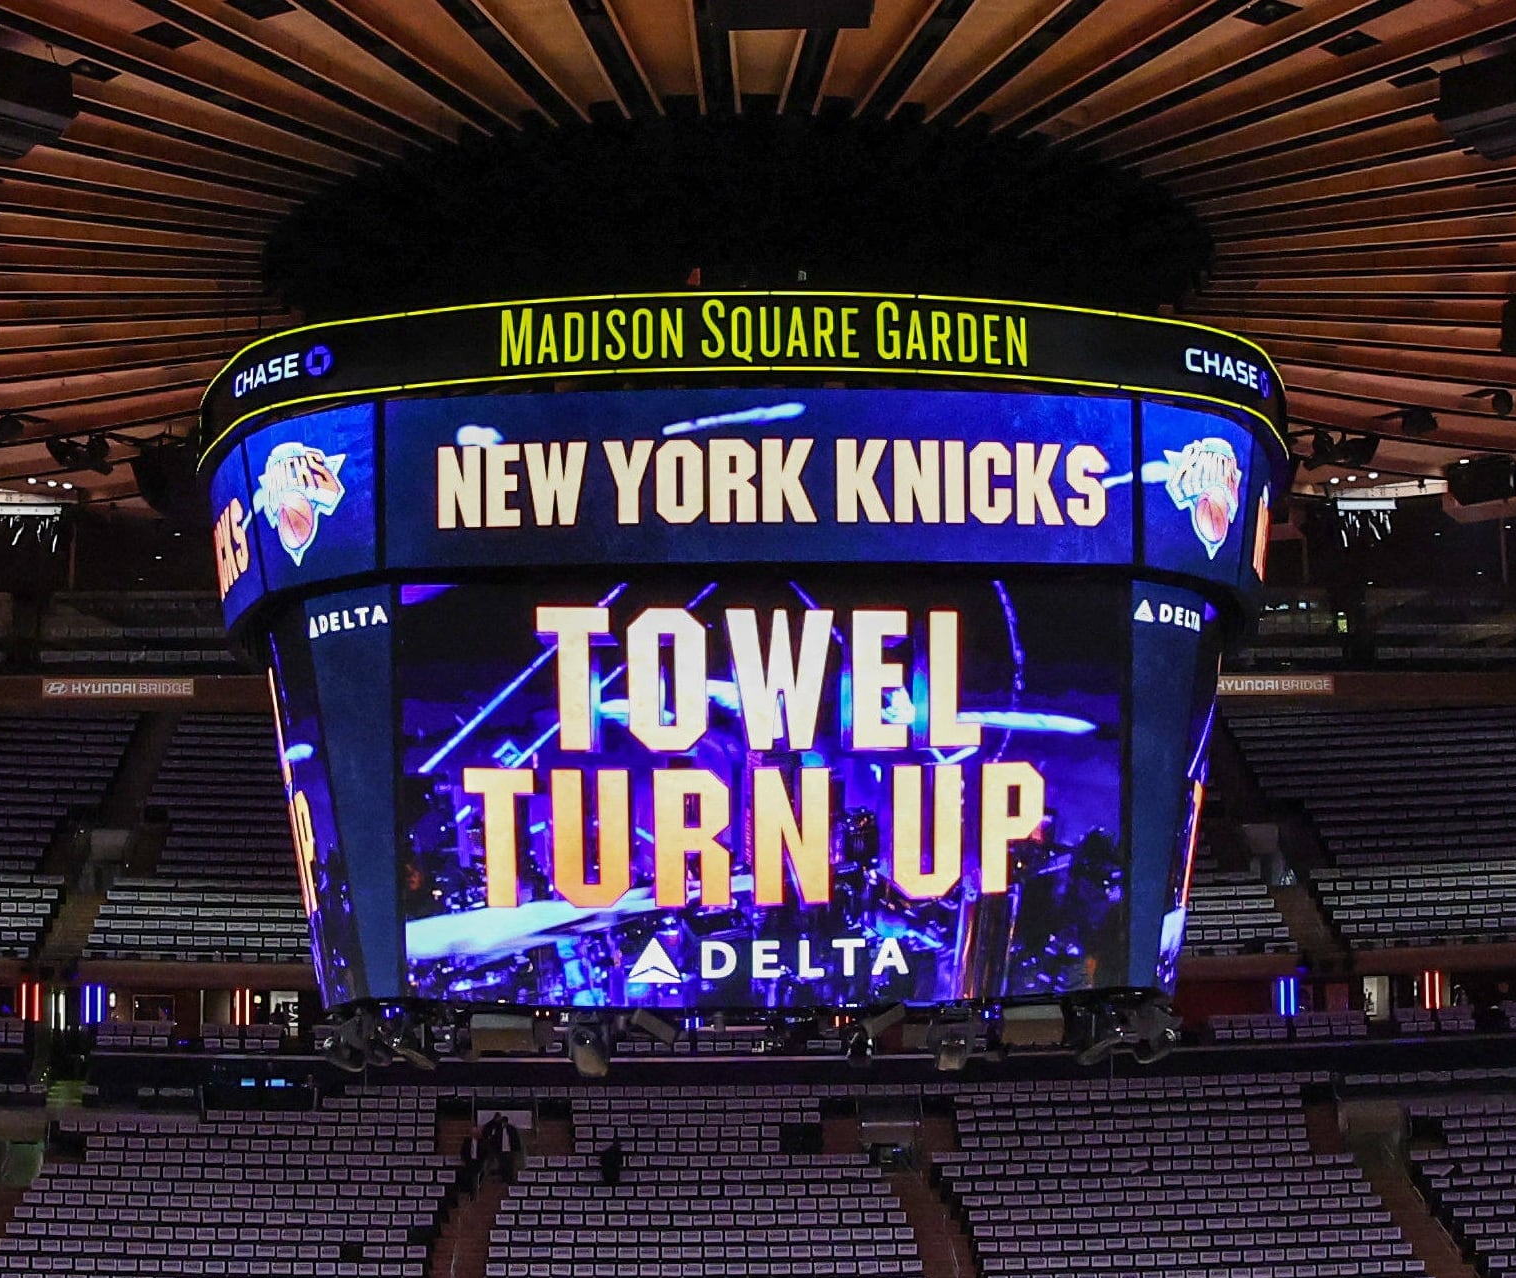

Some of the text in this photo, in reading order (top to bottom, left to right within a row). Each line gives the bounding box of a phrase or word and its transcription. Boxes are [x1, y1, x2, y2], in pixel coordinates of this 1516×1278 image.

[499, 299, 1029, 368] MADISON SQUARE GARDEN
[234, 353, 301, 398] CHASE
[1185, 346, 1260, 389] CHASE
[436, 438, 1109, 529] NEW YORK KNICKS
[319, 602, 389, 636] DELTA
[1158, 602, 1204, 633] DELTA
[70, 681, 191, 696] HYUNDAI BRIDGE
[535, 606, 982, 752] TOWEL
[1282, 677, 1332, 692] BRIDGE
[463, 761, 1046, 909] TURN UP
[700, 937, 910, 980] DELTA
